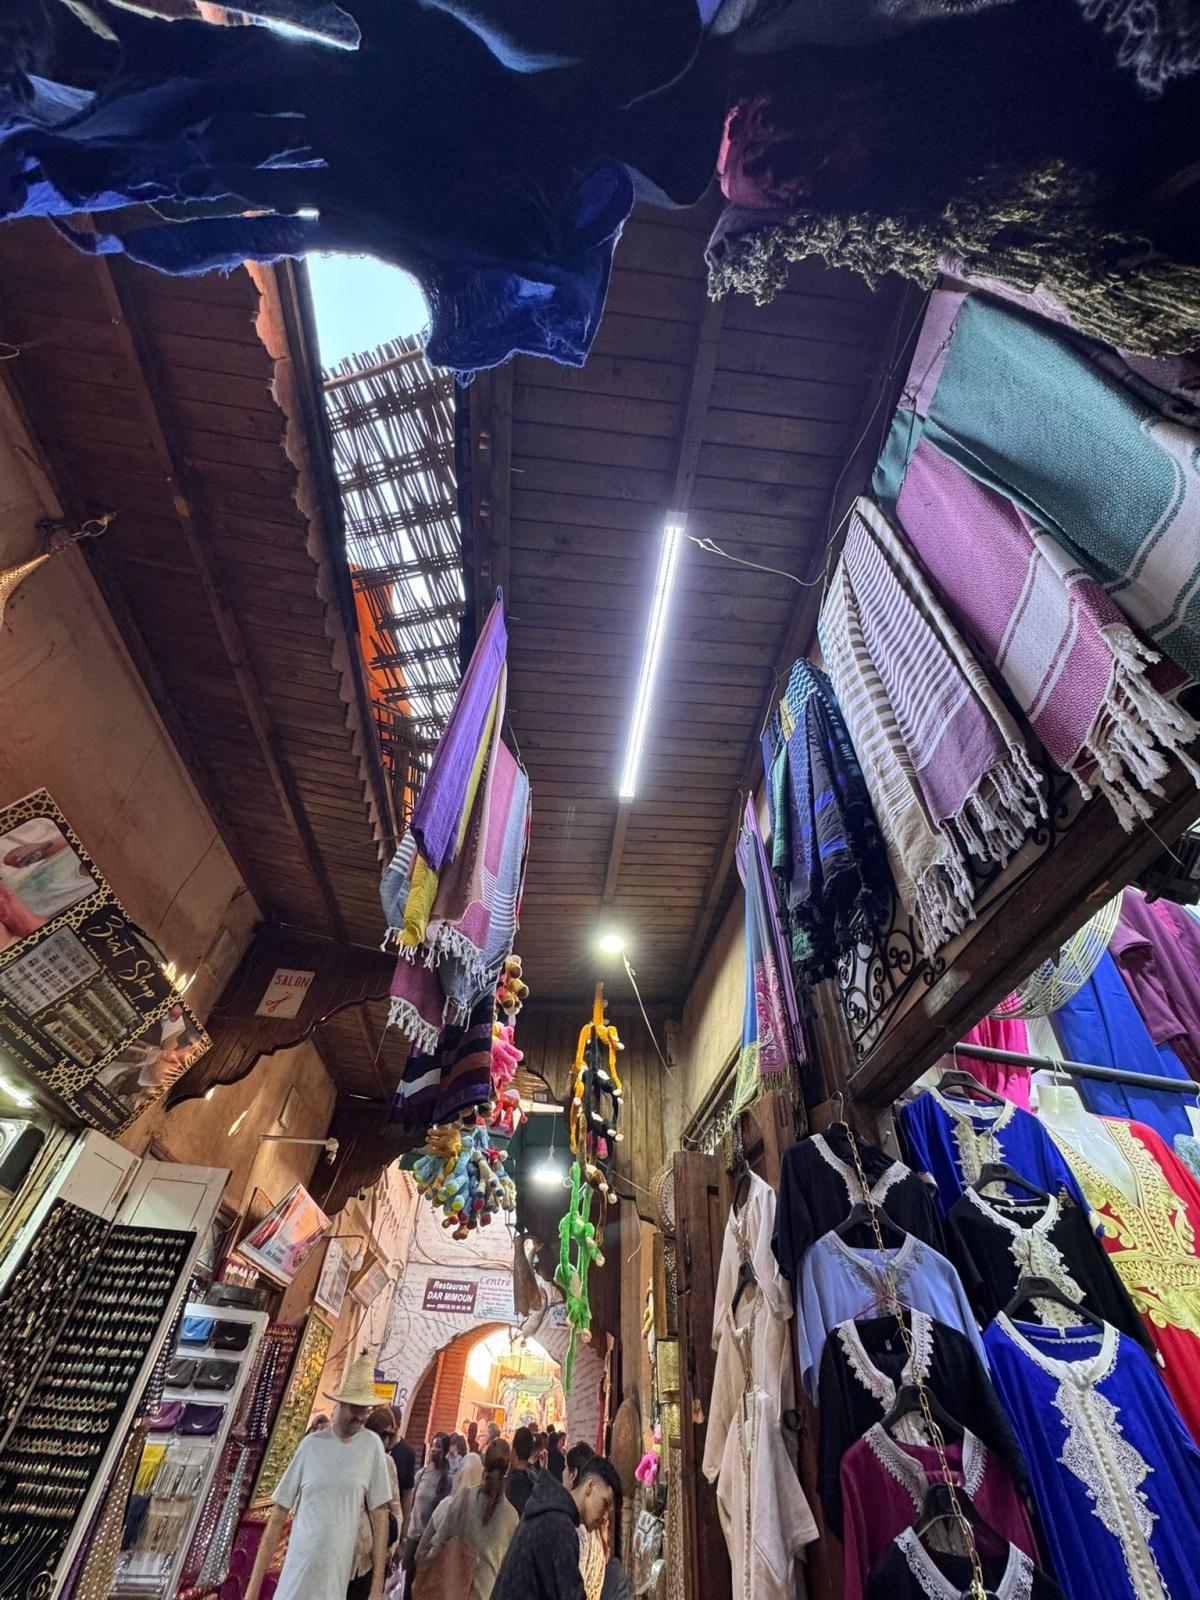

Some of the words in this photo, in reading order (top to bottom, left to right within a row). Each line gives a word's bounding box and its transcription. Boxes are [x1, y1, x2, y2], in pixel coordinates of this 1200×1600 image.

[117, 960, 155, 1000] Shop
[274, 974, 311, 988] SALON
[433, 1281, 471, 1292] Restaurant
[480, 1275, 512, 1287] Centre
[427, 1291, 443, 1300] DAR
[444, 1293, 474, 1303] MIMOUN
